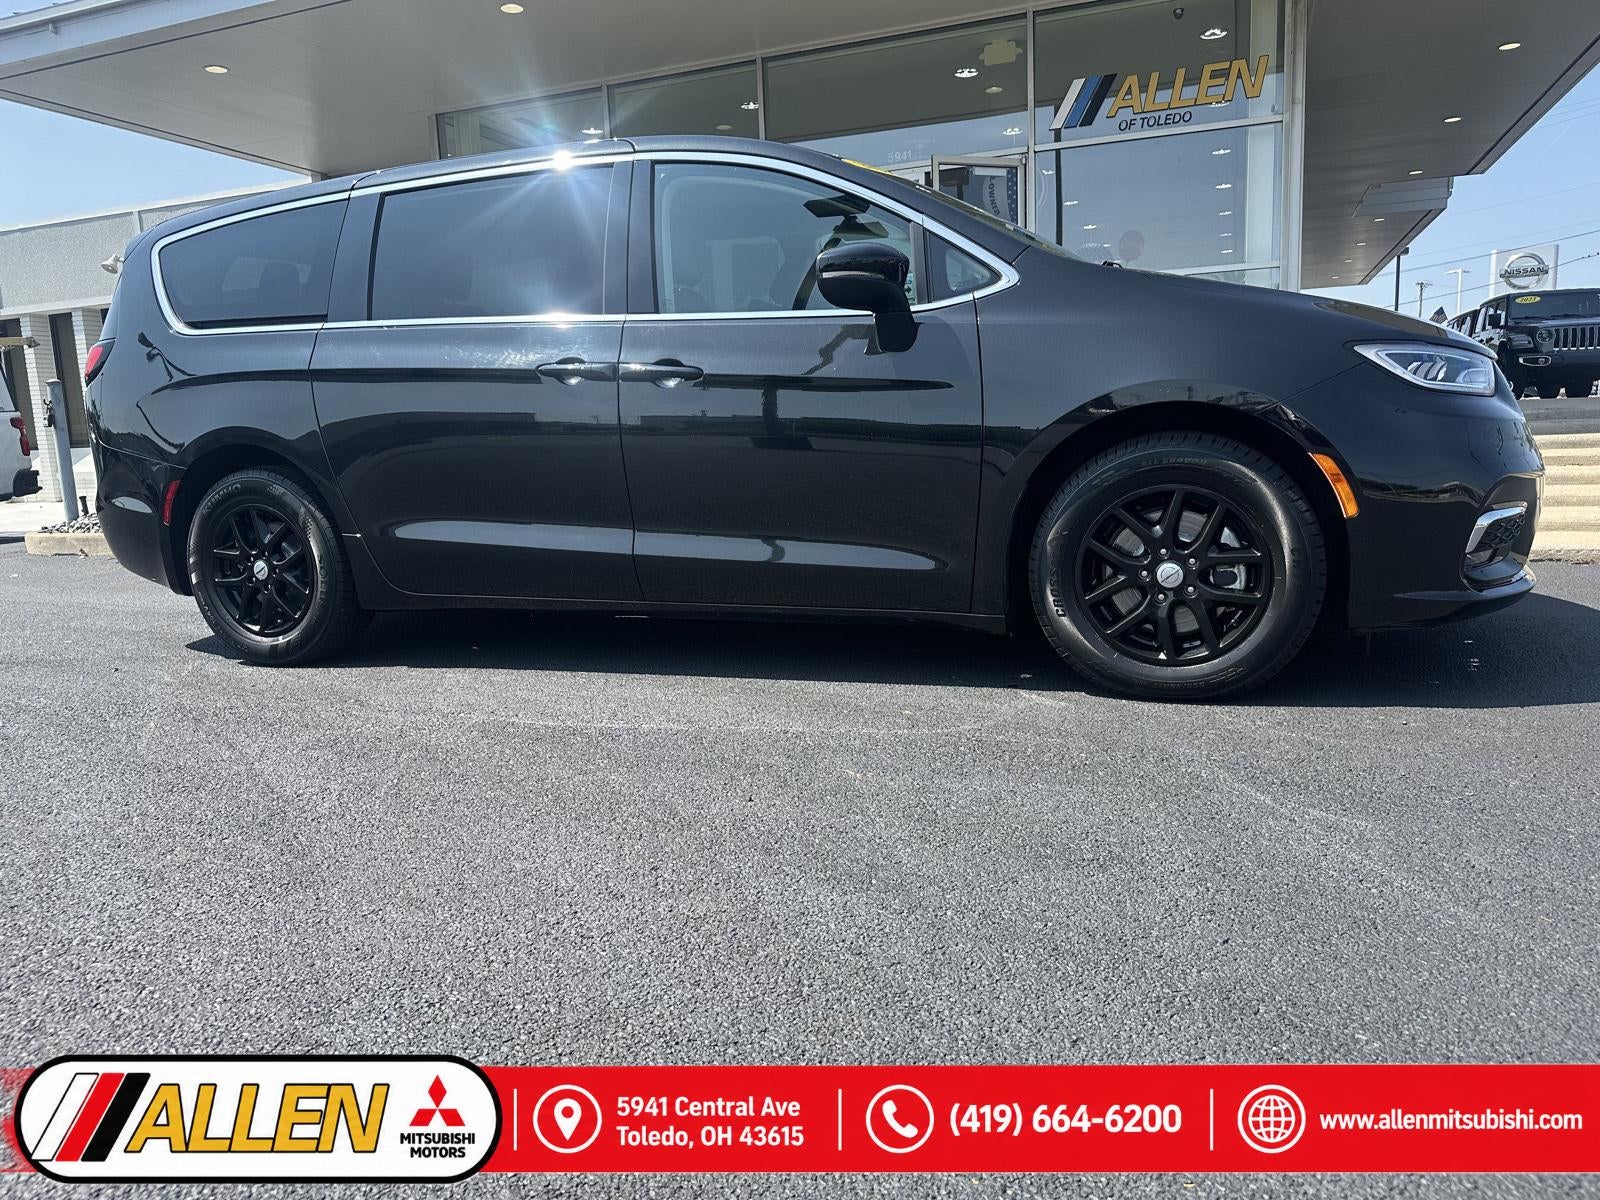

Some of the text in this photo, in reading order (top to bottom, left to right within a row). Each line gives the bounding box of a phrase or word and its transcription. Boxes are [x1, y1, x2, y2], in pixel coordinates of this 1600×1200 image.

[1106, 55, 1269, 118] ALLEN
[1118, 110, 1193, 131] OF TOLEDO
[888, 150, 912, 162] 5941
[1504, 266, 1545, 276] NISSAN
